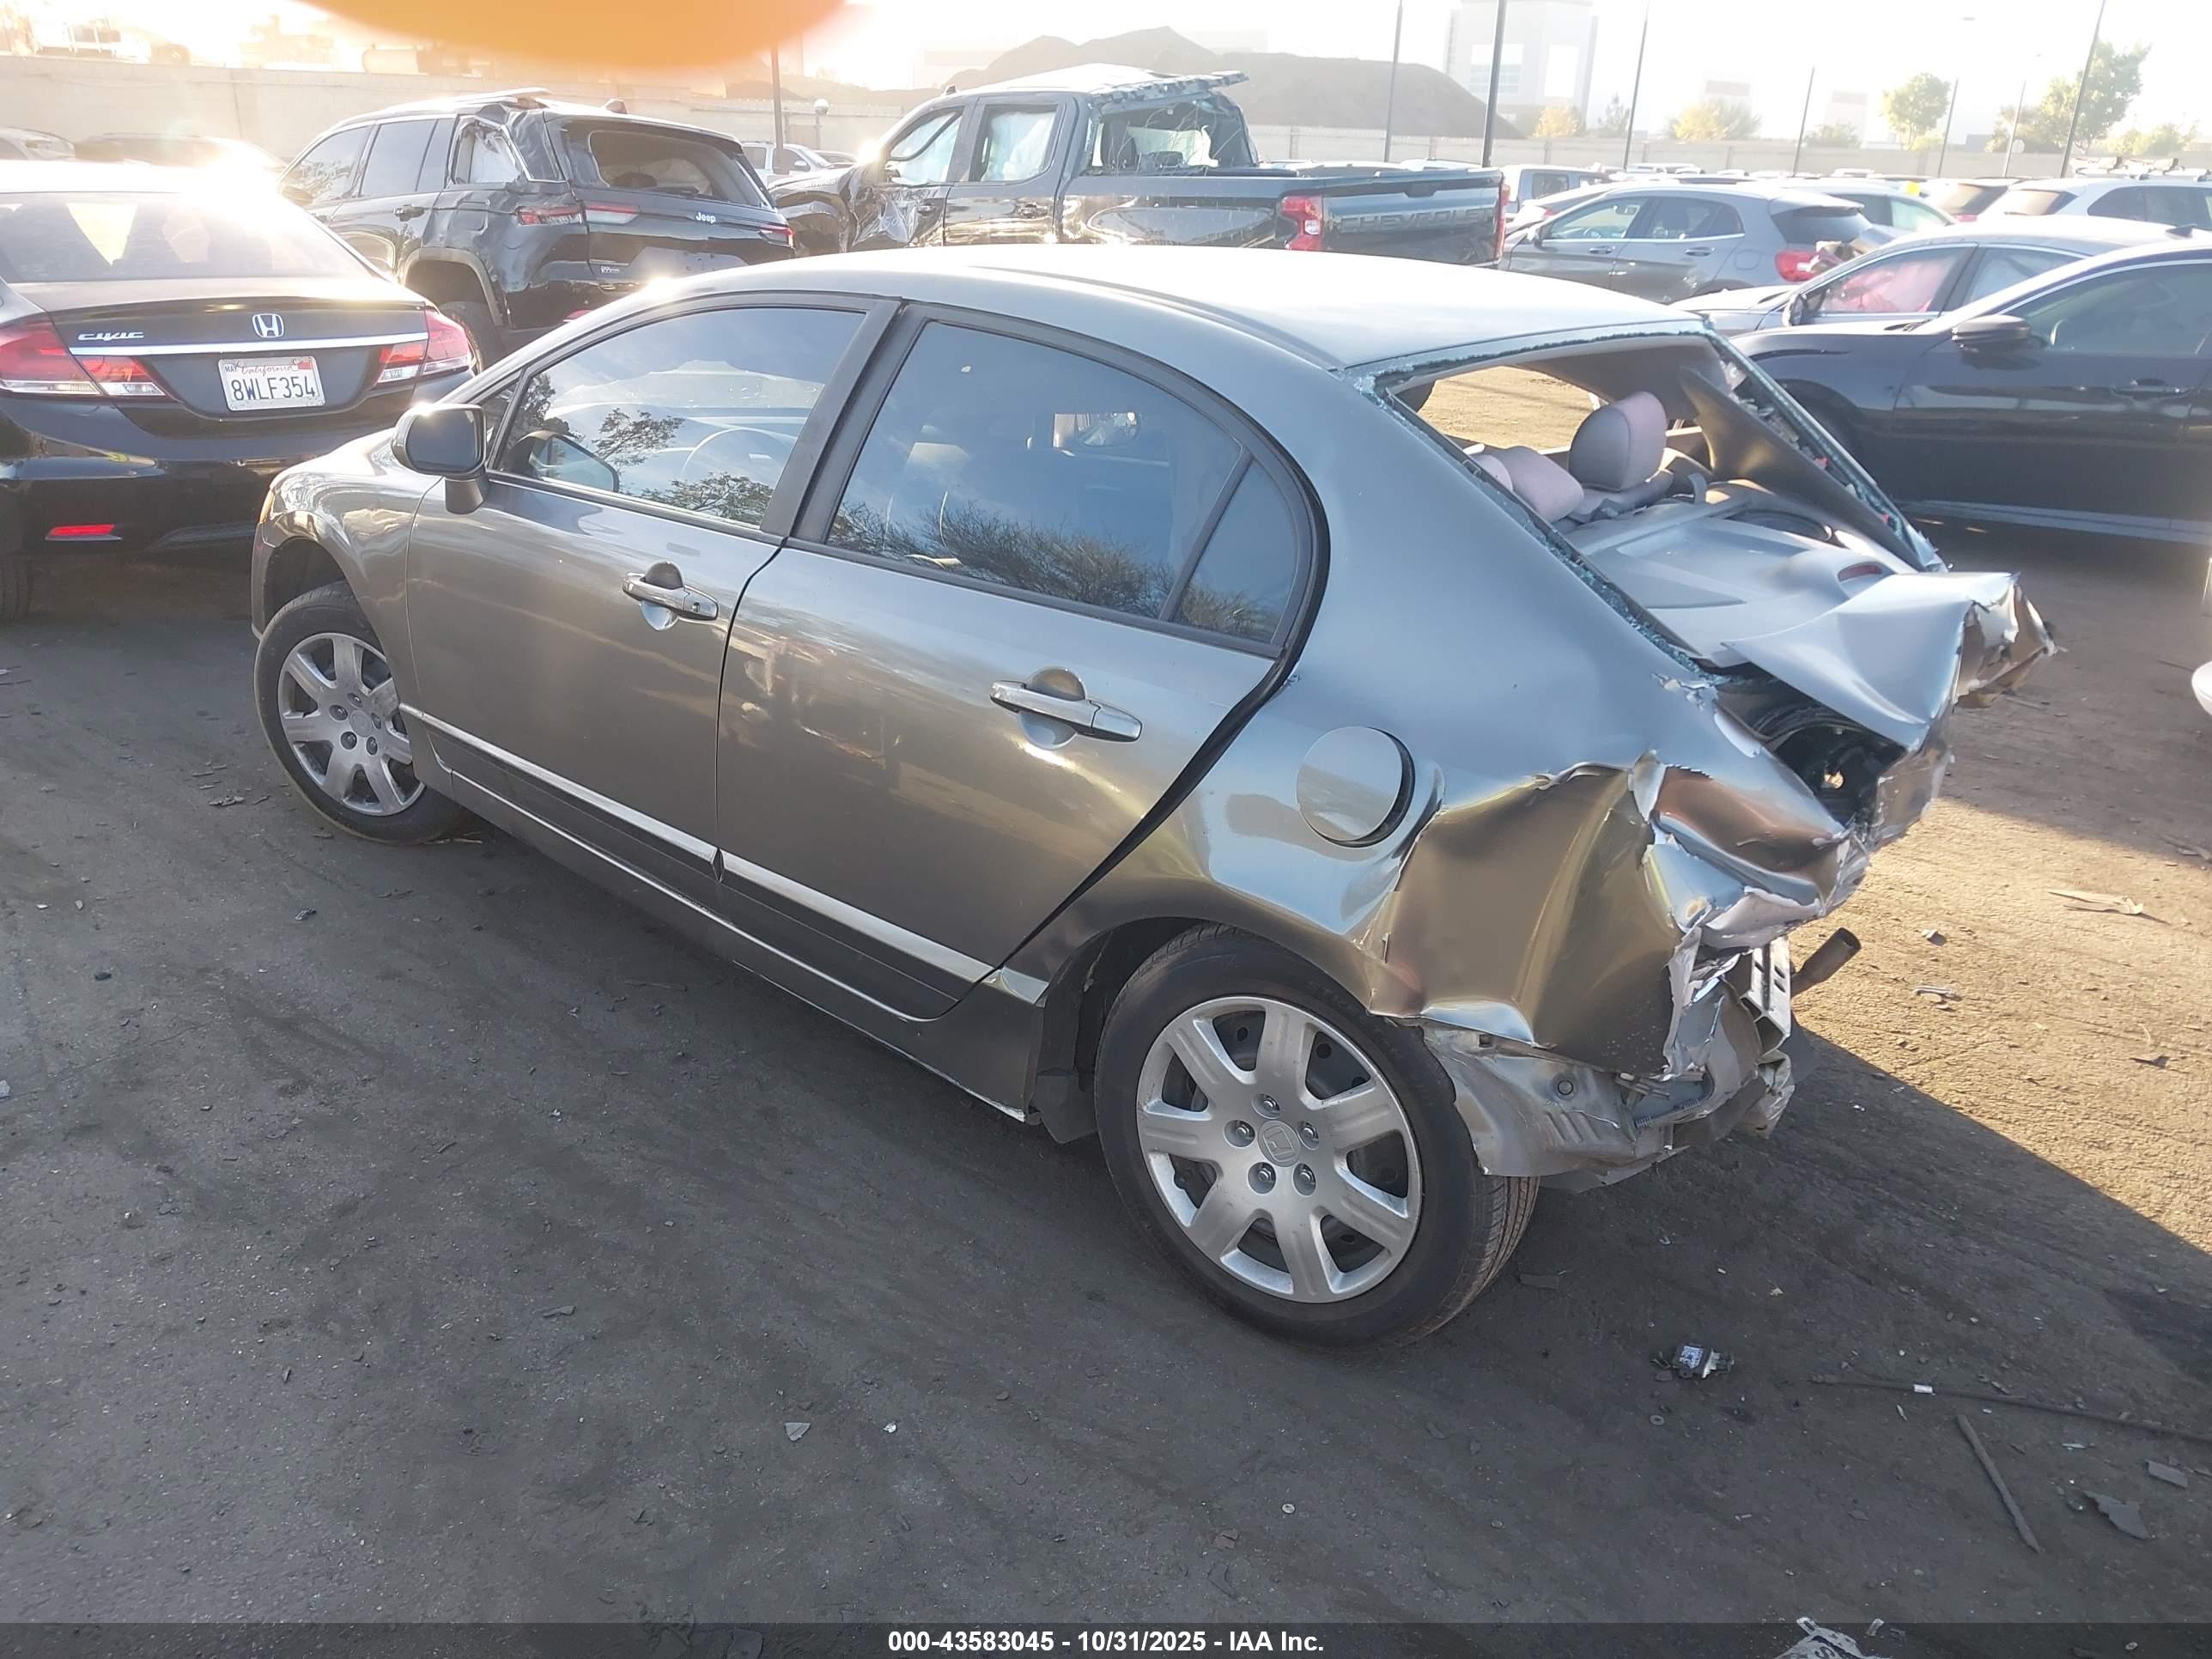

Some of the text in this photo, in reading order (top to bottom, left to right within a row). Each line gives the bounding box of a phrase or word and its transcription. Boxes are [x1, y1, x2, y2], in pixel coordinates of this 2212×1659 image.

[696, 211, 716, 224] Jeep
[77, 331, 144, 341] CIVIC
[231, 375, 316, 402] 8WLF354
